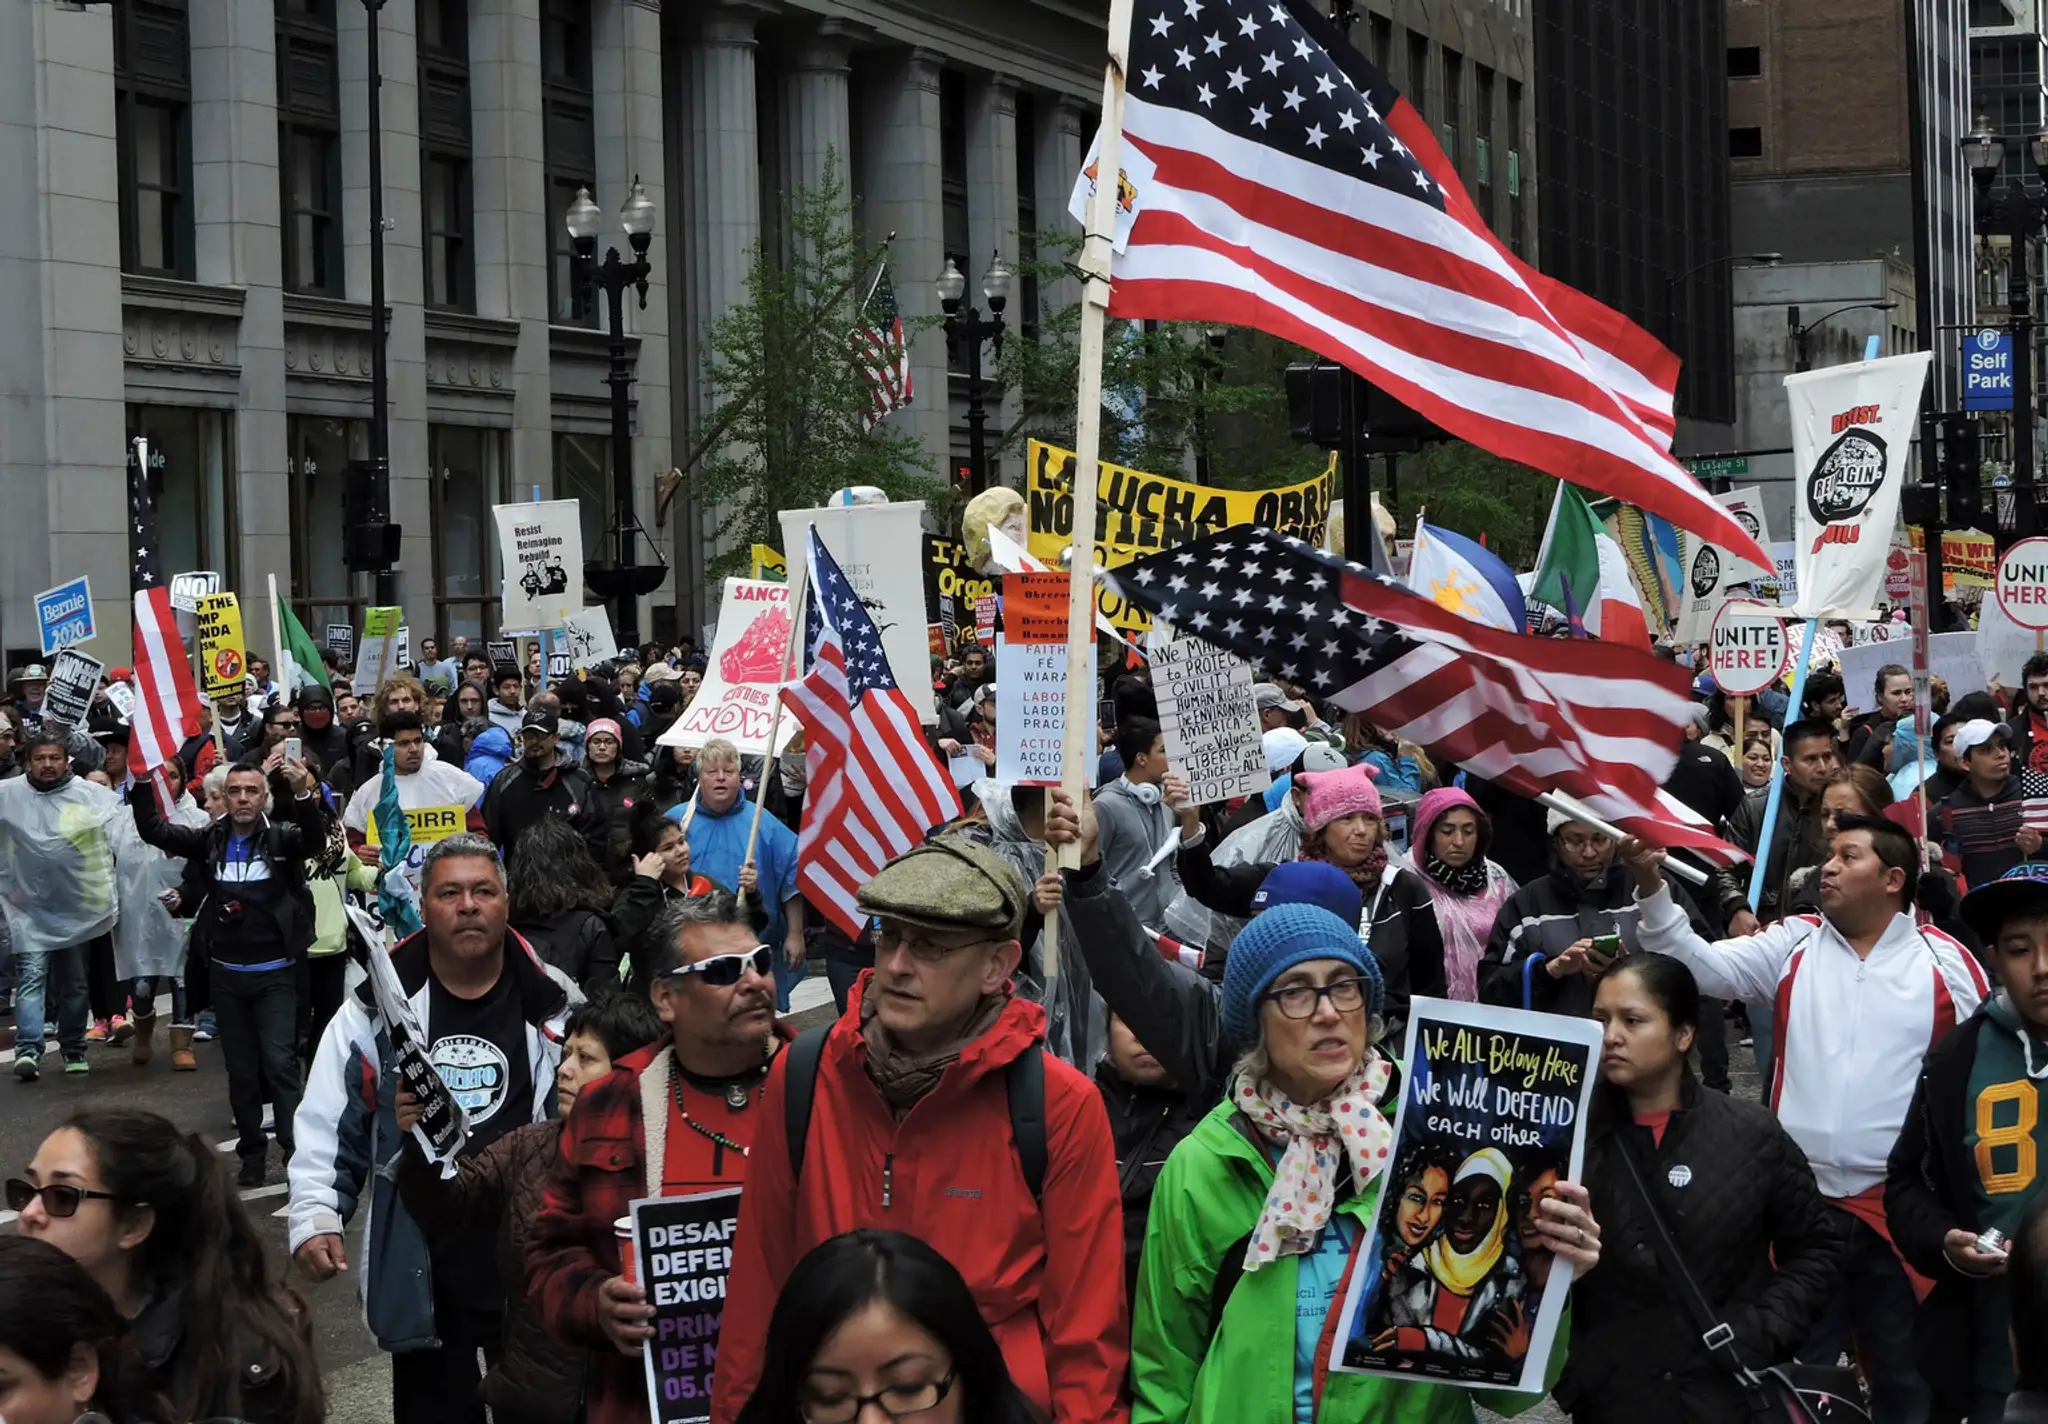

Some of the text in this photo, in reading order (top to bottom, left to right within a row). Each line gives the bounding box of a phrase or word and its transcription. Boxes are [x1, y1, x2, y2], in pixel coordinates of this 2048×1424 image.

[1970, 353, 2007, 369] Self
[1967, 373, 2011, 389] Park
[1701, 458, 1732, 471] LaSalle
[1736, 459, 1745, 468] St
[1030, 490, 1075, 536] NO
[514, 525, 542, 537] Resist
[517, 536, 563, 550] Reimagine
[518, 550, 550, 564] Rebuild
[734, 584, 790, 601] SANCT
[43, 594, 85, 622] Bernie
[207, 597, 234, 610] THE
[51, 620, 85, 647] 2020
[1715, 626, 1779, 647] UNITE
[1025, 645, 1066, 655] FAITH
[1154, 645, 1180, 663] We
[1038, 656, 1054, 668] FÉ
[1024, 672, 1068, 682] WIARA
[1166, 668, 1181, 681] to
[1171, 670, 1232, 697] CIVILITY
[722, 685, 770, 707] CITIES
[1176, 684, 1251, 713] HUMAN RIGHTS
[683, 703, 788, 740] NOW
[1193, 698, 1255, 725] ENVIRONMENT
[1180, 714, 1252, 741] AMERICA'S
[1244, 745, 1263, 759] and
[1190, 764, 1227, 783] JUSTICE
[1229, 763, 1241, 773] for
[1190, 774, 1252, 803] HOPE
[1423, 1026, 1450, 1061] We
[1452, 1028, 1487, 1064] ALL
[1489, 1034, 1540, 1088] Belong
[405, 1061, 424, 1081] We
[415, 1084, 429, 1099] to
[1413, 1071, 1441, 1106] We
[1447, 1073, 1489, 1114] Will
[1974, 1079, 2038, 1194] 8
[648, 1217, 737, 1248] DESAF
[661, 1346, 697, 1371] DE
